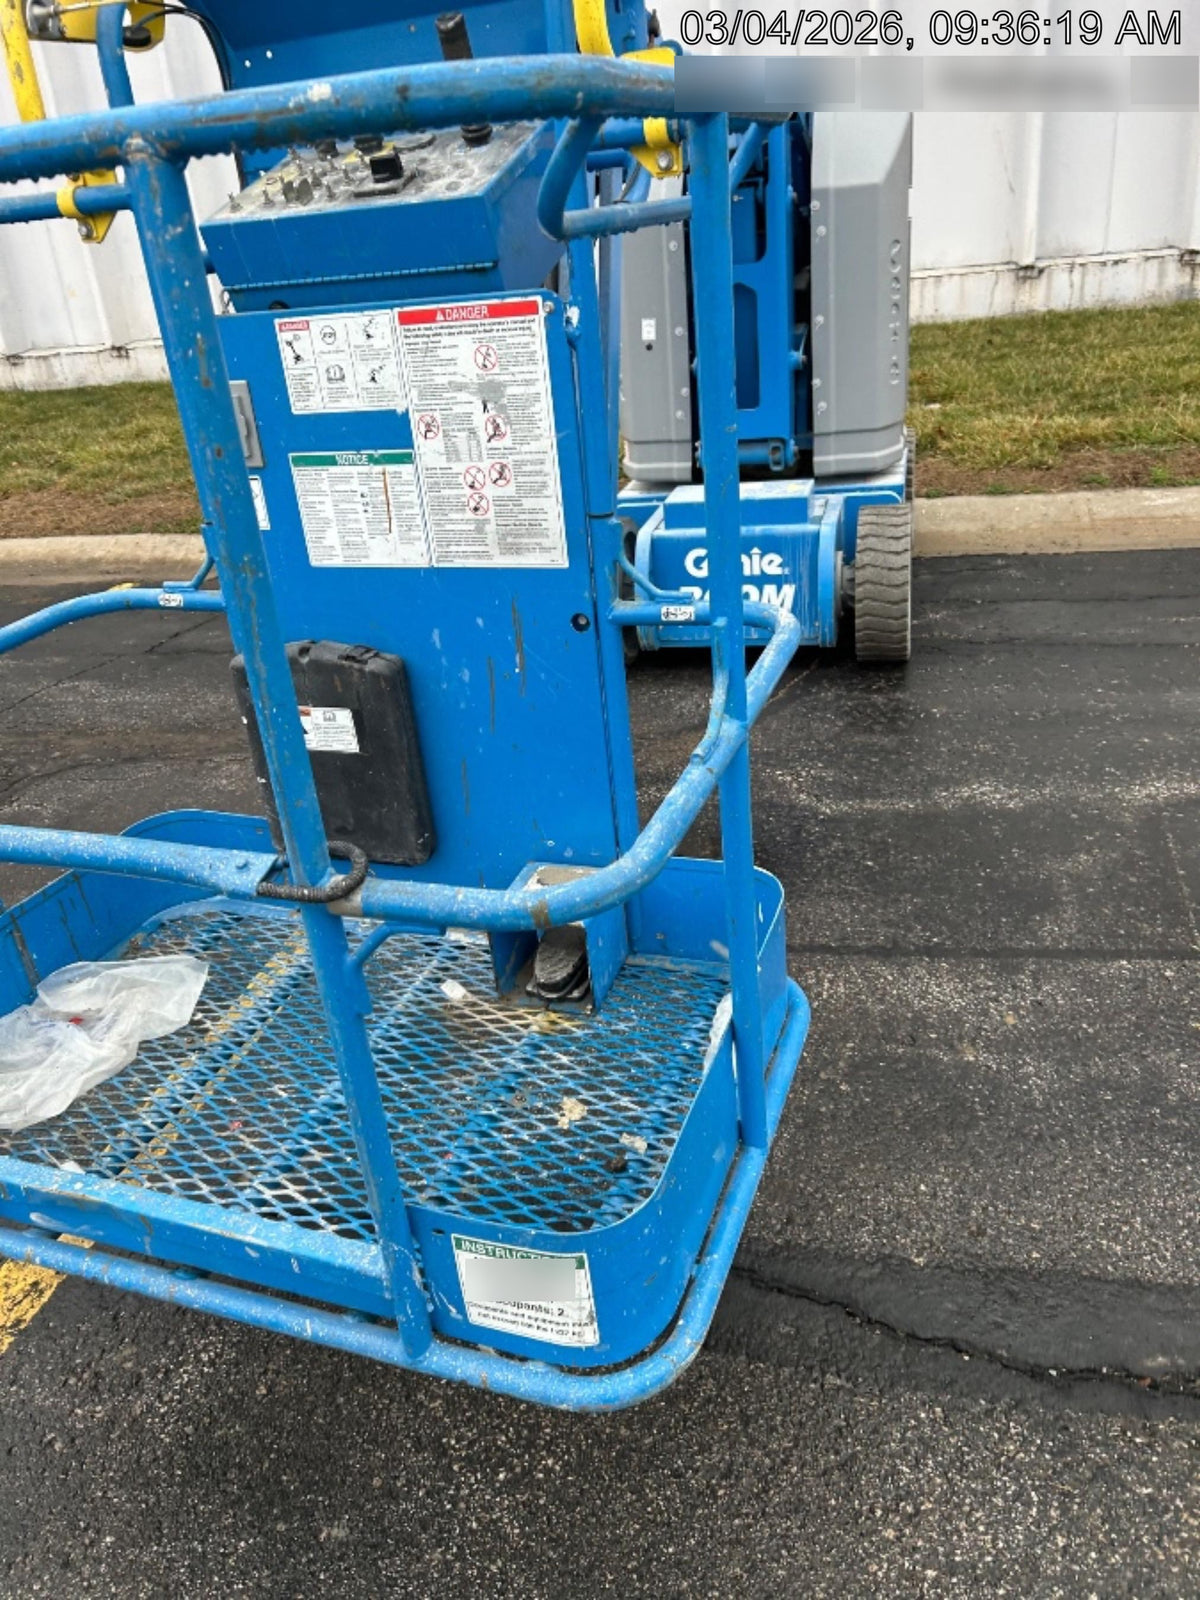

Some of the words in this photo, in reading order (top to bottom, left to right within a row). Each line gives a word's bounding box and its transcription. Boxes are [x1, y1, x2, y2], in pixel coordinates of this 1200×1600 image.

[445, 305, 489, 321] DANGER
[336, 454, 368, 465] NOTICE
[684, 547, 783, 578] Gnie
[557, 1307, 565, 1317] 2
